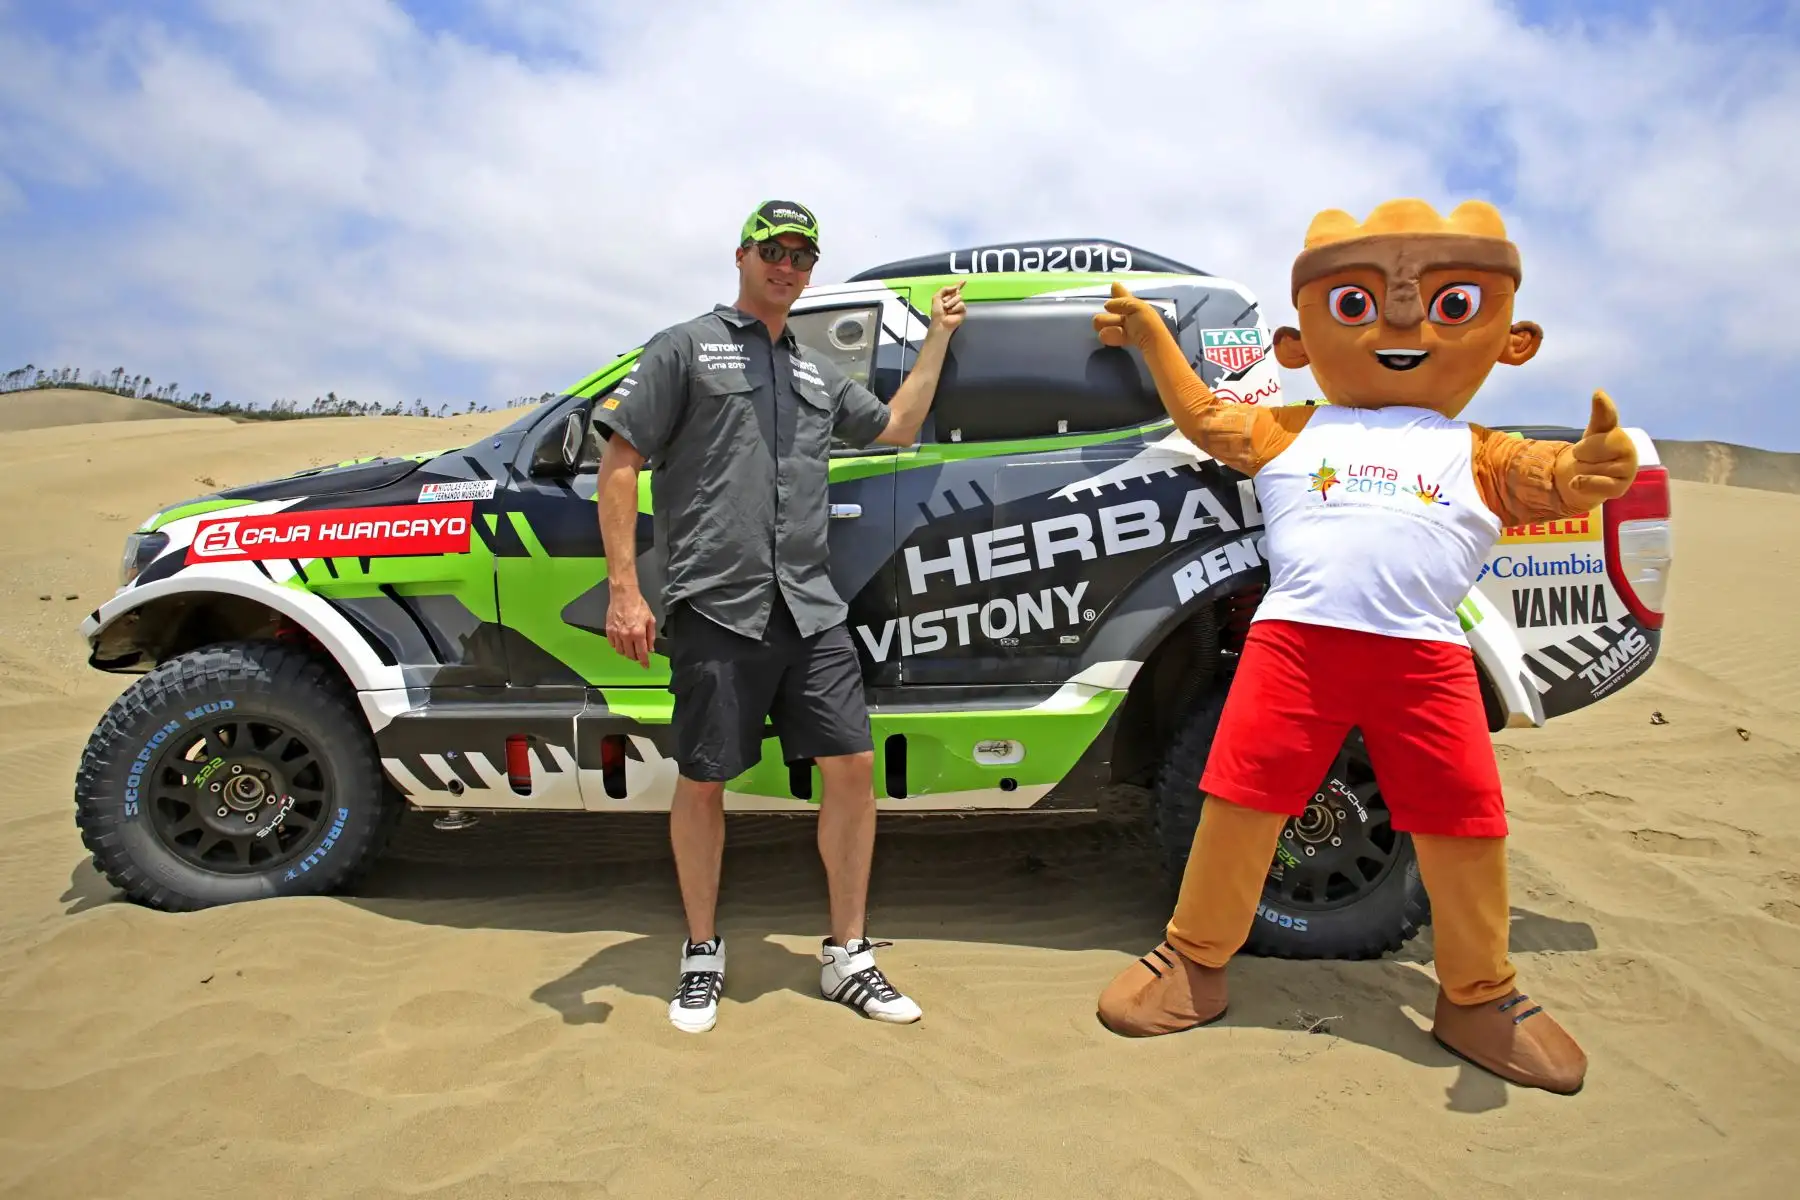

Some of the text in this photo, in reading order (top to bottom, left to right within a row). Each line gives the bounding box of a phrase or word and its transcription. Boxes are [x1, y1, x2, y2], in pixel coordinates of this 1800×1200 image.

[700, 342, 744, 352] VISTONY
[1206, 330, 1257, 345] TAG
[728, 361, 746, 369] 2019
[1207, 348, 1261, 370] HEUER
[434, 491, 461, 501] FERNANDO
[1345, 478, 1397, 496] 2019
[242, 518, 466, 545] CAJA HUANCAYO
[1500, 519, 1589, 537] RELLI
[1491, 553, 1604, 578] Columbia
[1512, 584, 1608, 628] VANNA
[125, 720, 181, 816] SCORPION
[185, 700, 235, 720] MUD
[193, 757, 226, 789] 322
[1330, 778, 1368, 822] FUCHS
[256, 796, 295, 839] FUCHS
[300, 807, 349, 873] PIRELLI
